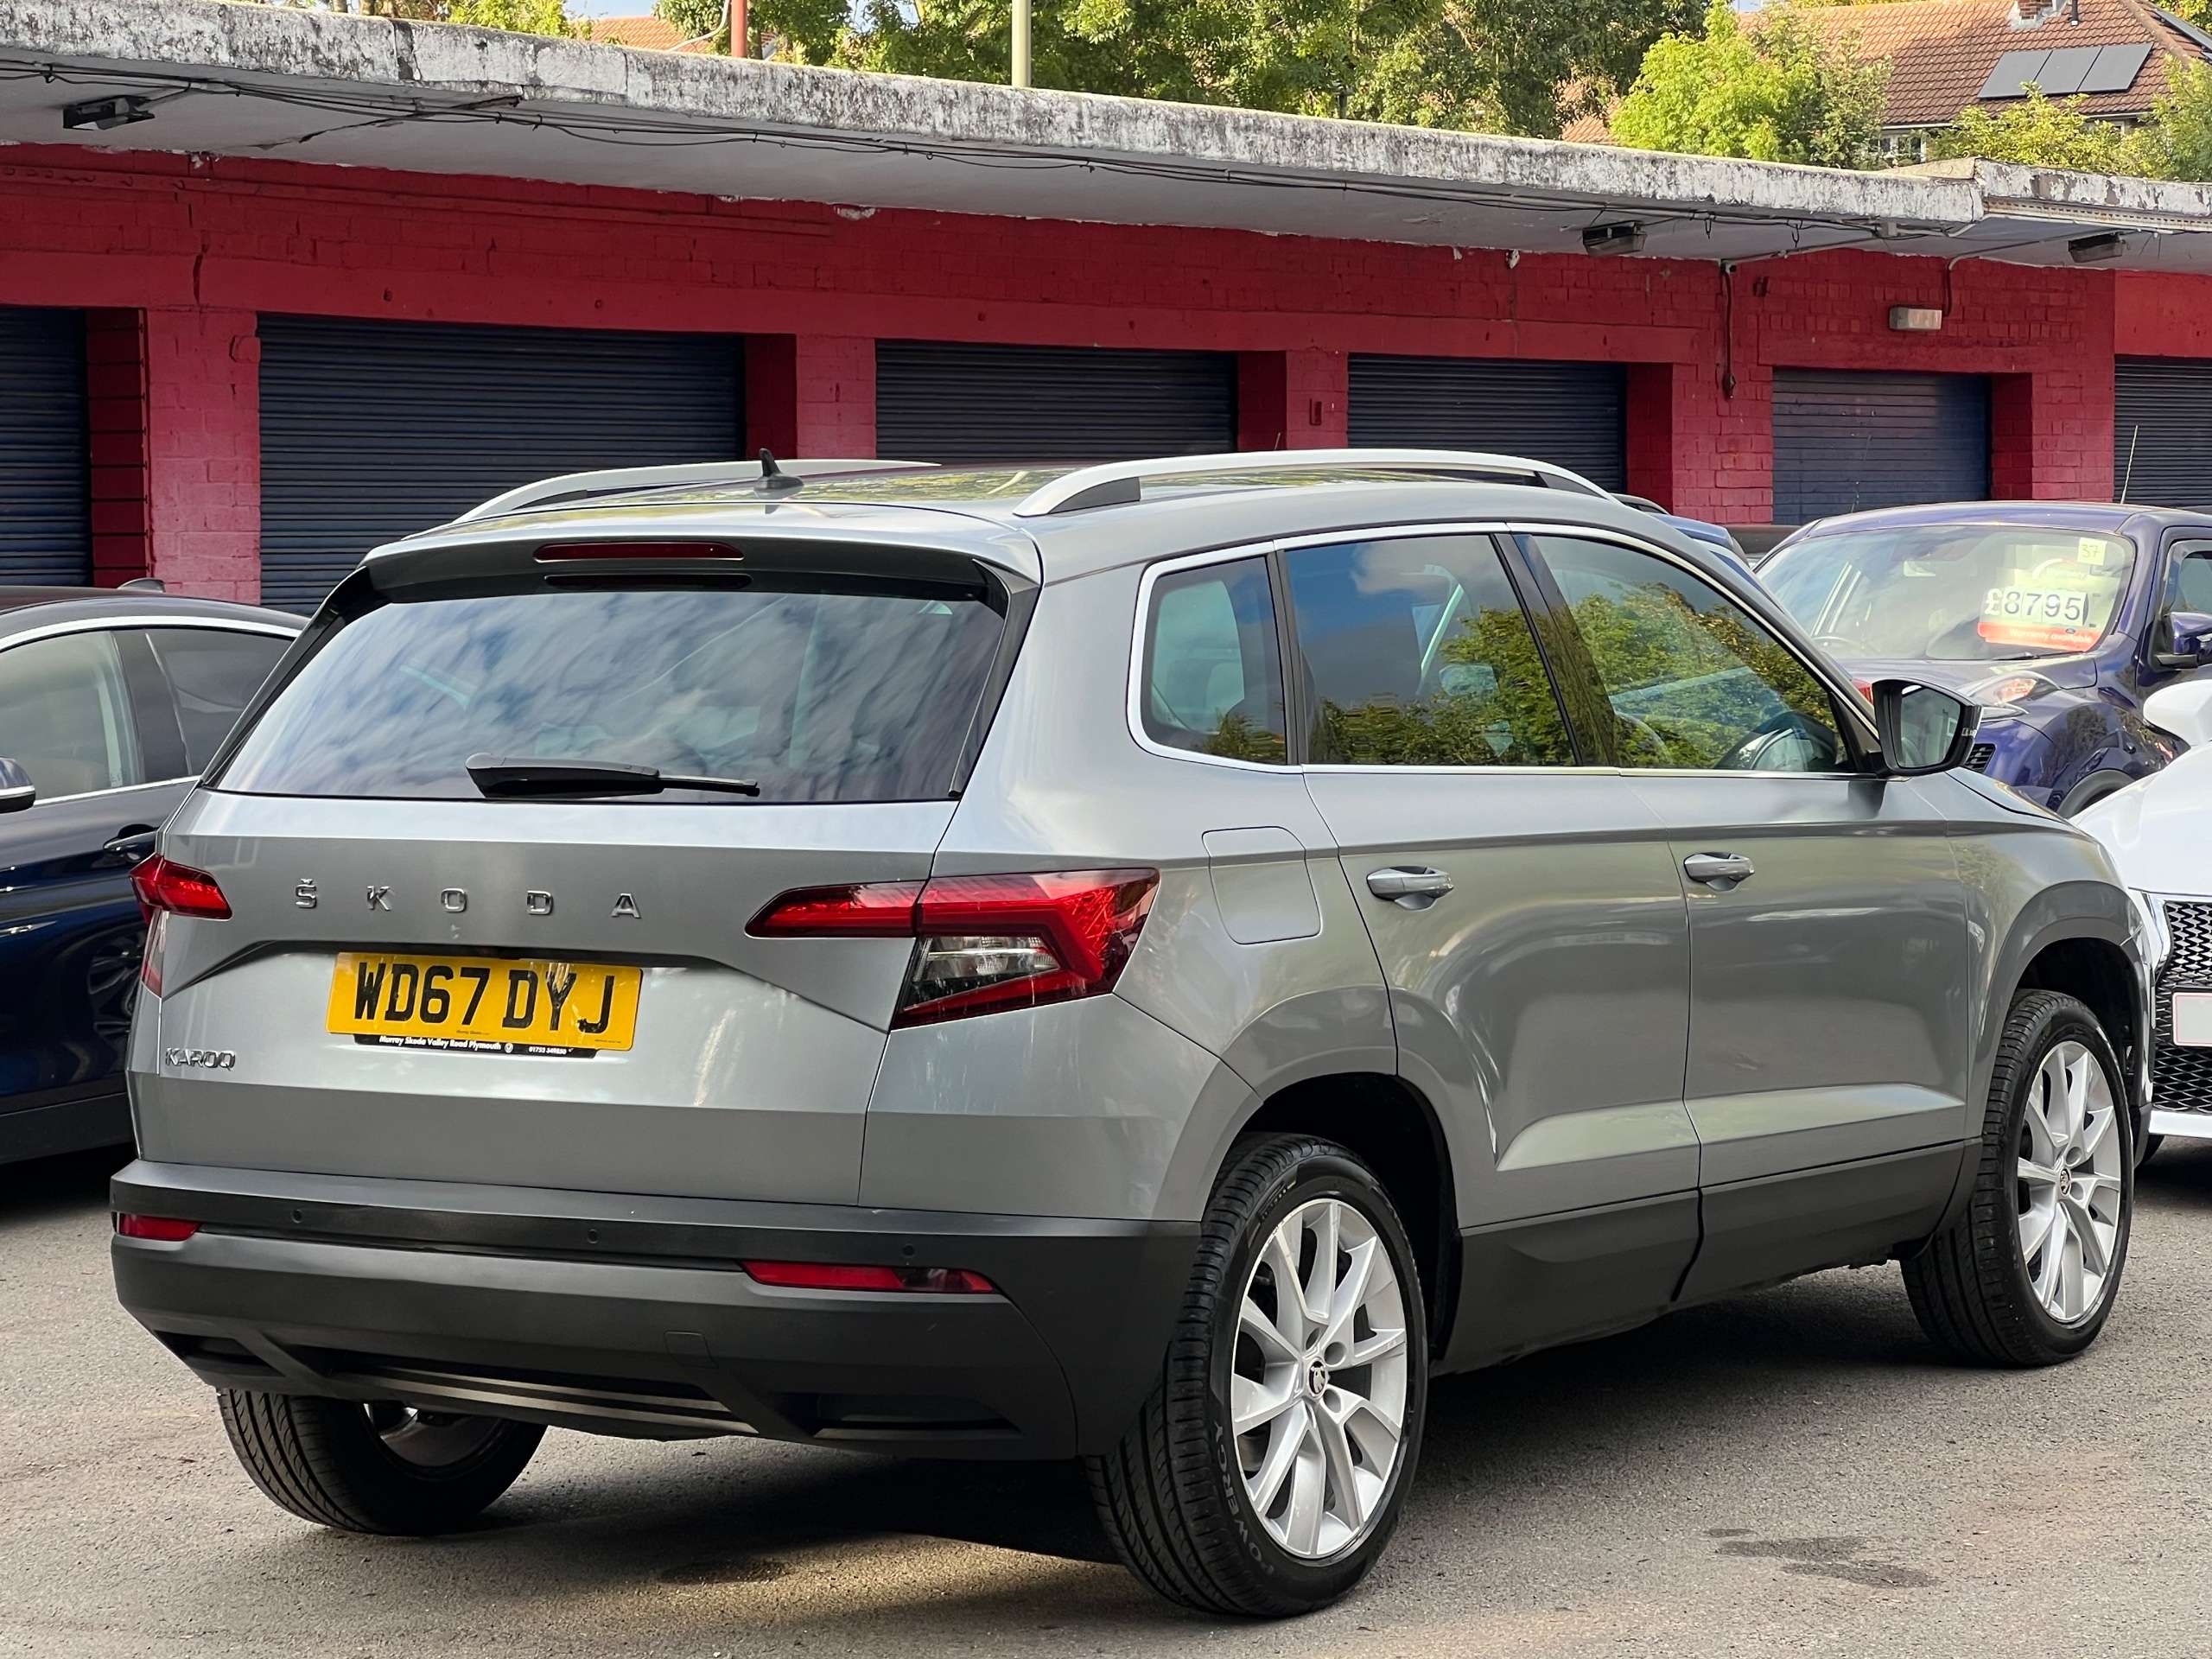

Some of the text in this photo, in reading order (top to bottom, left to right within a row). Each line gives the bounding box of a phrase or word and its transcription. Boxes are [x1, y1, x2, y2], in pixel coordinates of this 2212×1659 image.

[1985, 588, 2082, 621] £8795
[353, 962, 615, 1034] WD67 DYJ
[404, 1036, 426, 1046] Skoda
[427, 1037, 449, 1049] Valley
[449, 1039, 467, 1048] Road
[468, 1040, 501, 1052] Plymouth
[166, 1047, 236, 1071] KAROQ
